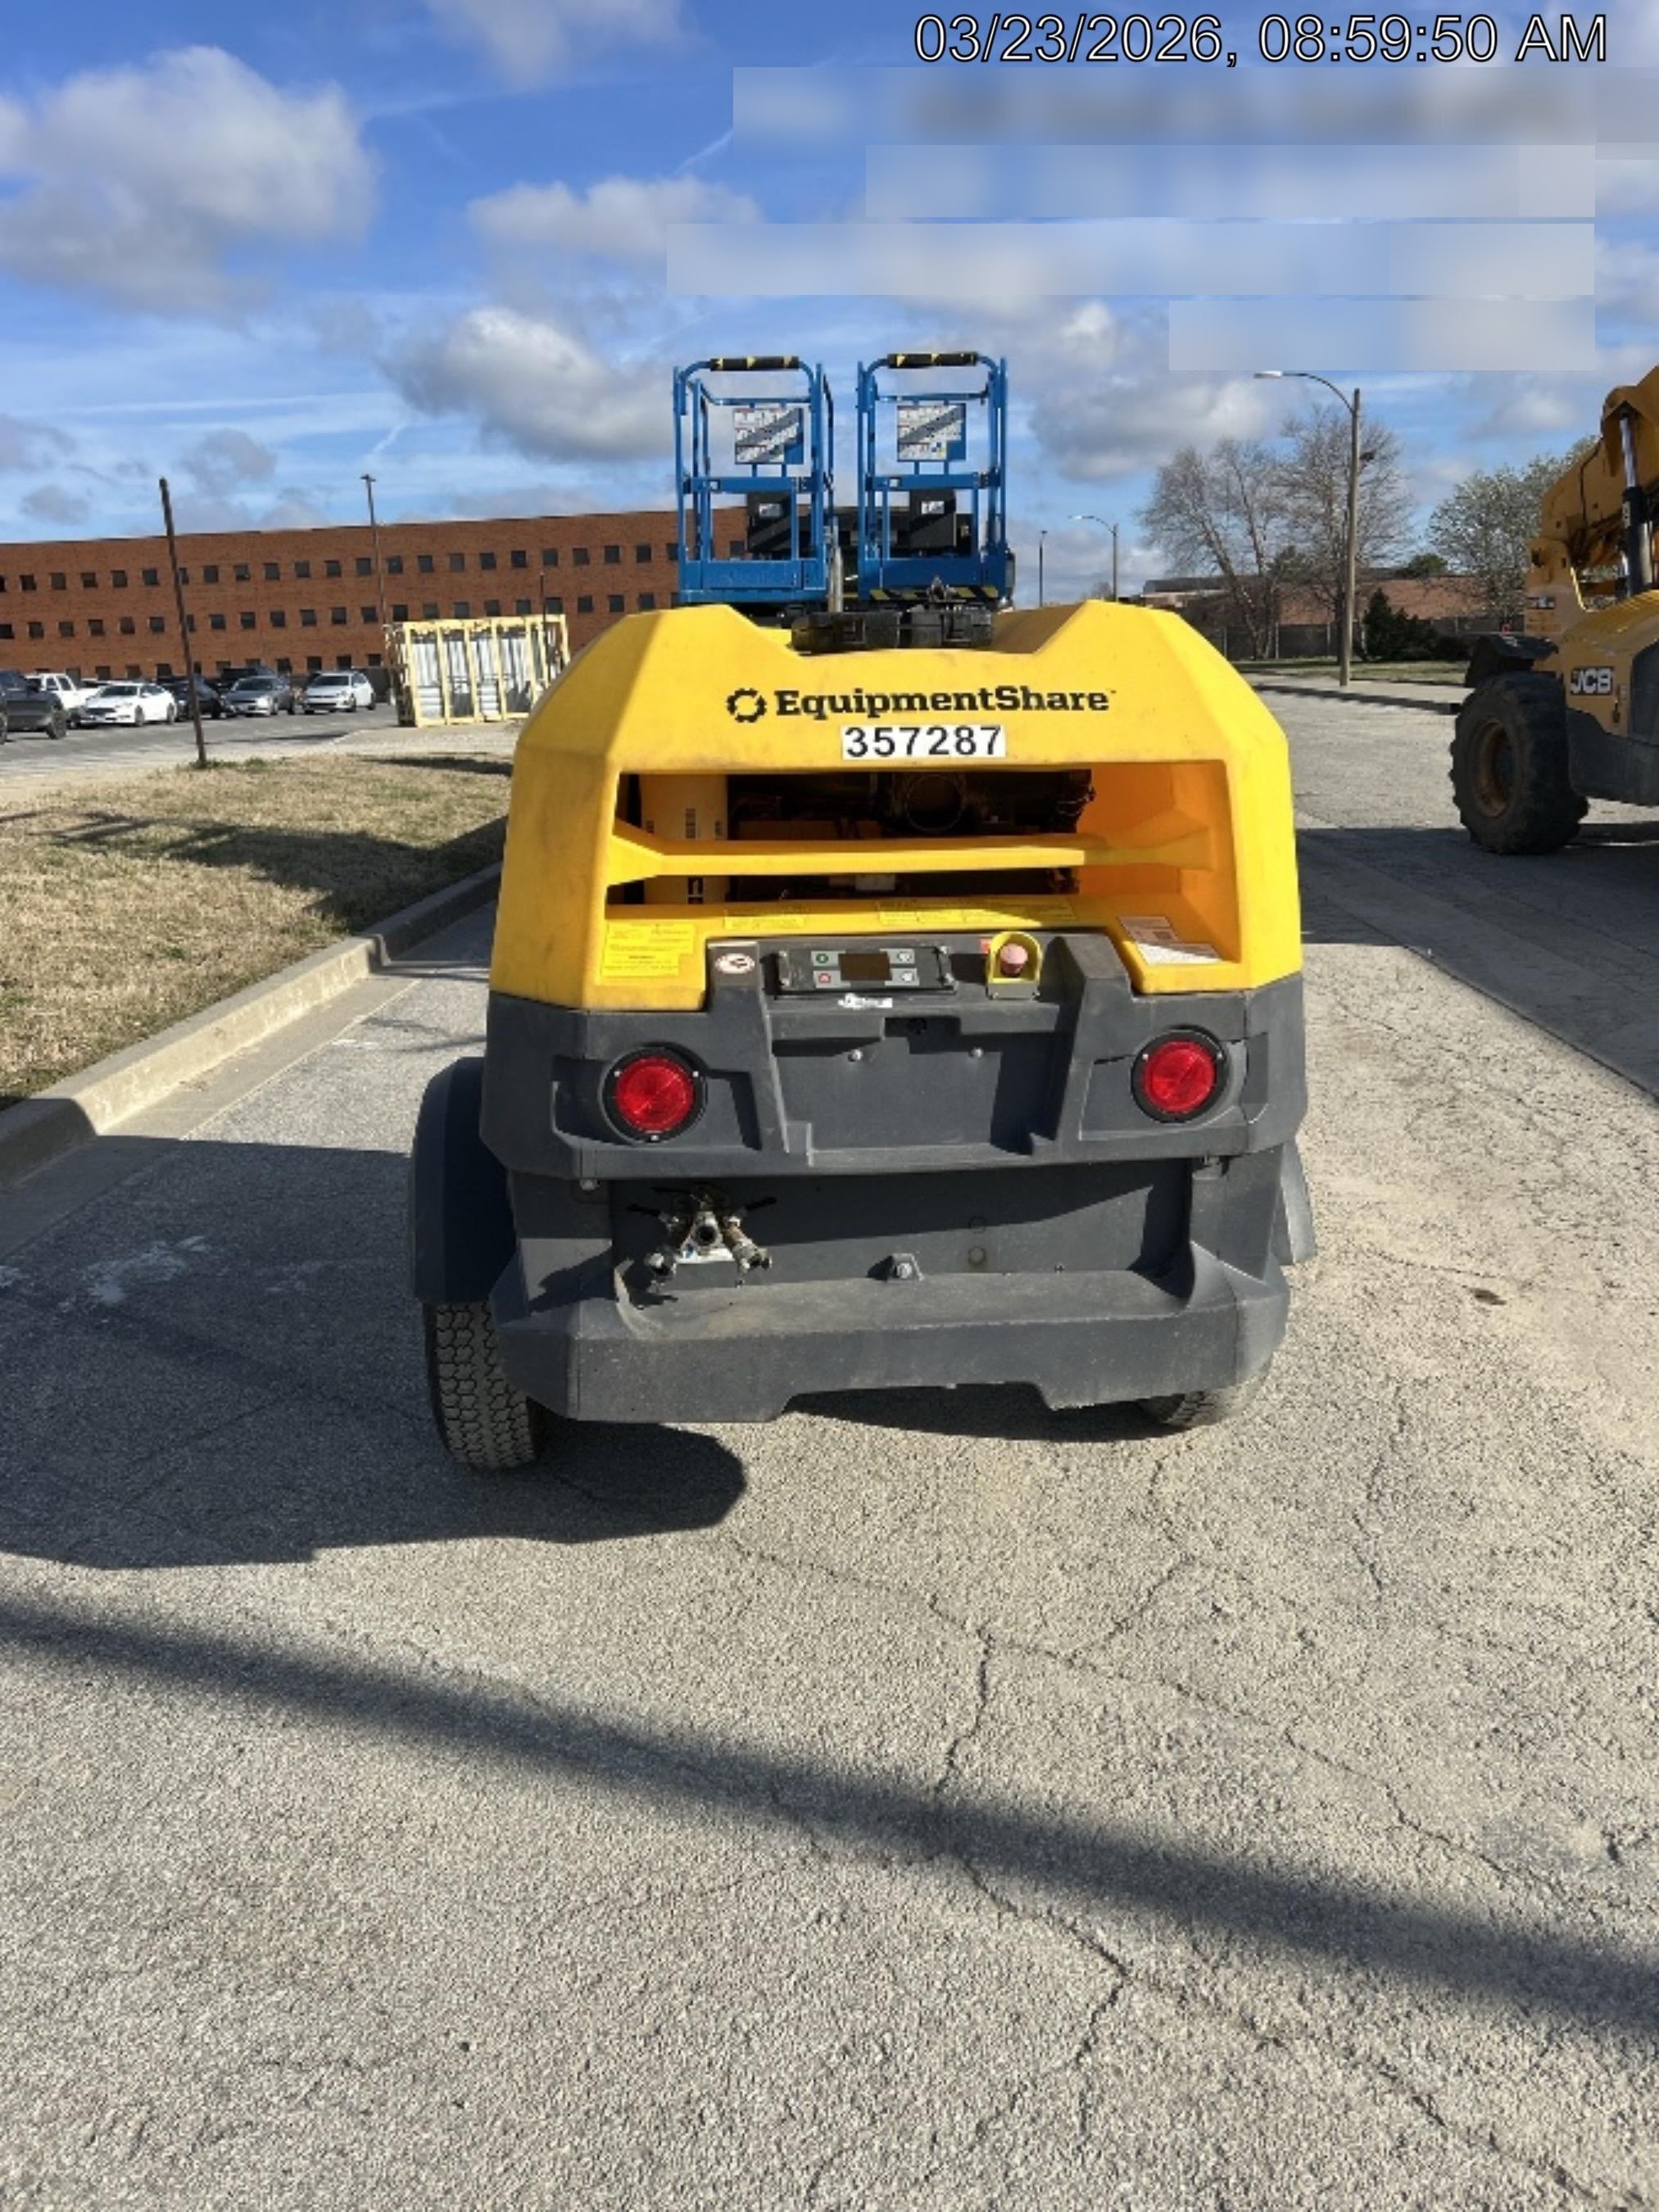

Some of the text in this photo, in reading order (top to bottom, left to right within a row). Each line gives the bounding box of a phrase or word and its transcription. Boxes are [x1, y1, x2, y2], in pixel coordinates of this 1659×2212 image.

[1571, 668, 1613, 694] JCB
[774, 686, 1109, 719] EquipmentShare
[845, 726, 1001, 757] 357287
